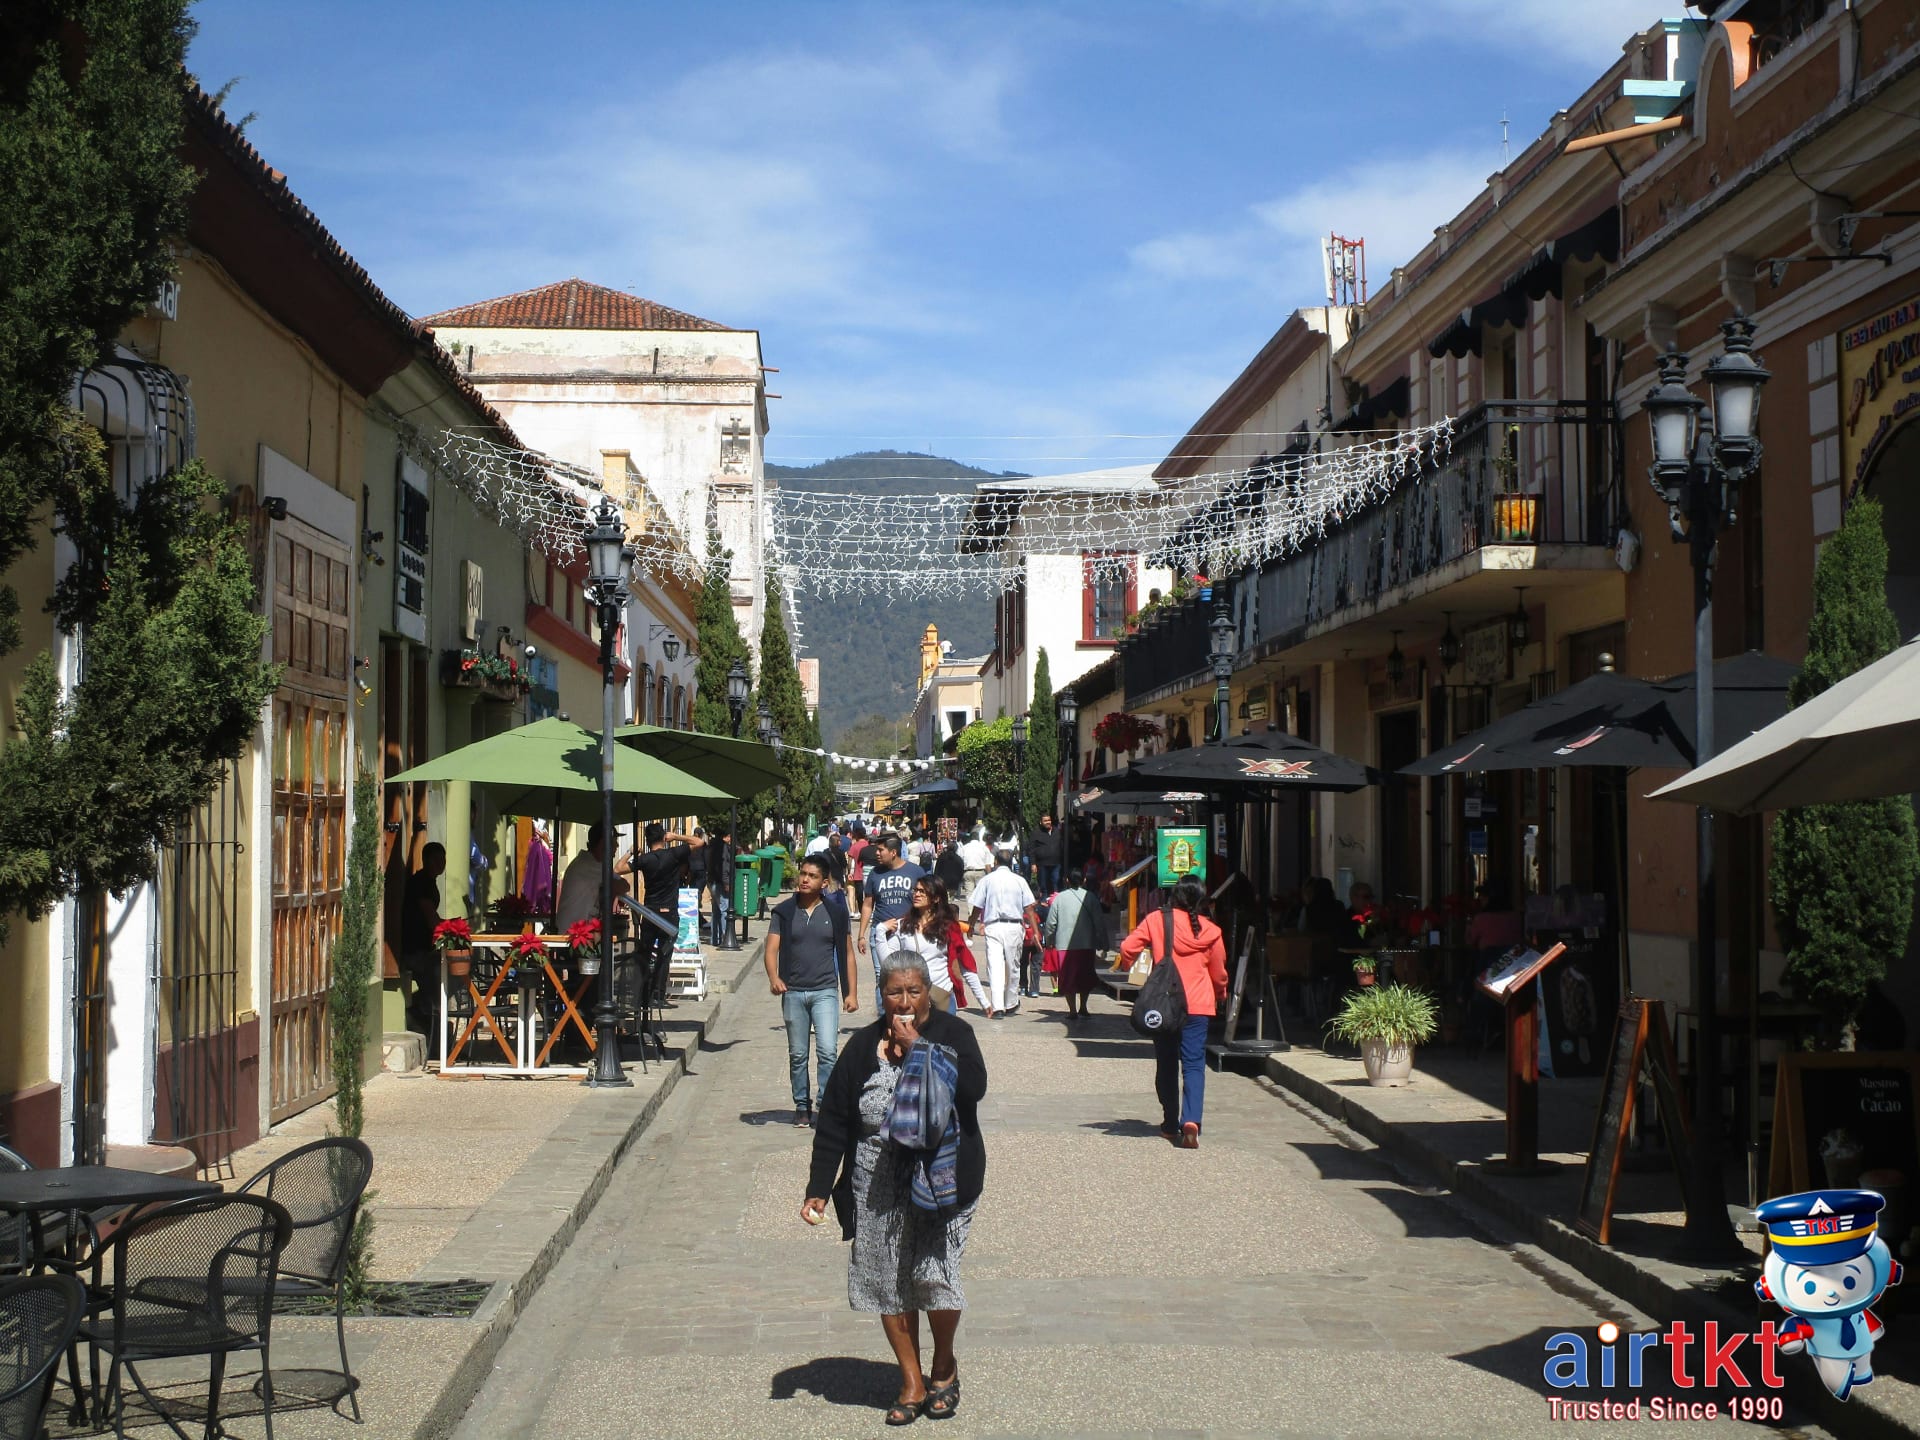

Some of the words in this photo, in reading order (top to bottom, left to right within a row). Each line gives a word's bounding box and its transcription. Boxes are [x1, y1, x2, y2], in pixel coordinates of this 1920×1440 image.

[878, 875, 911, 892] AERO
[880, 890, 893, 898] NEW
[893, 889, 909, 898] YORK
[1859, 1077, 1900, 1089] Maestros
[1860, 1096, 1902, 1113] Cacao
